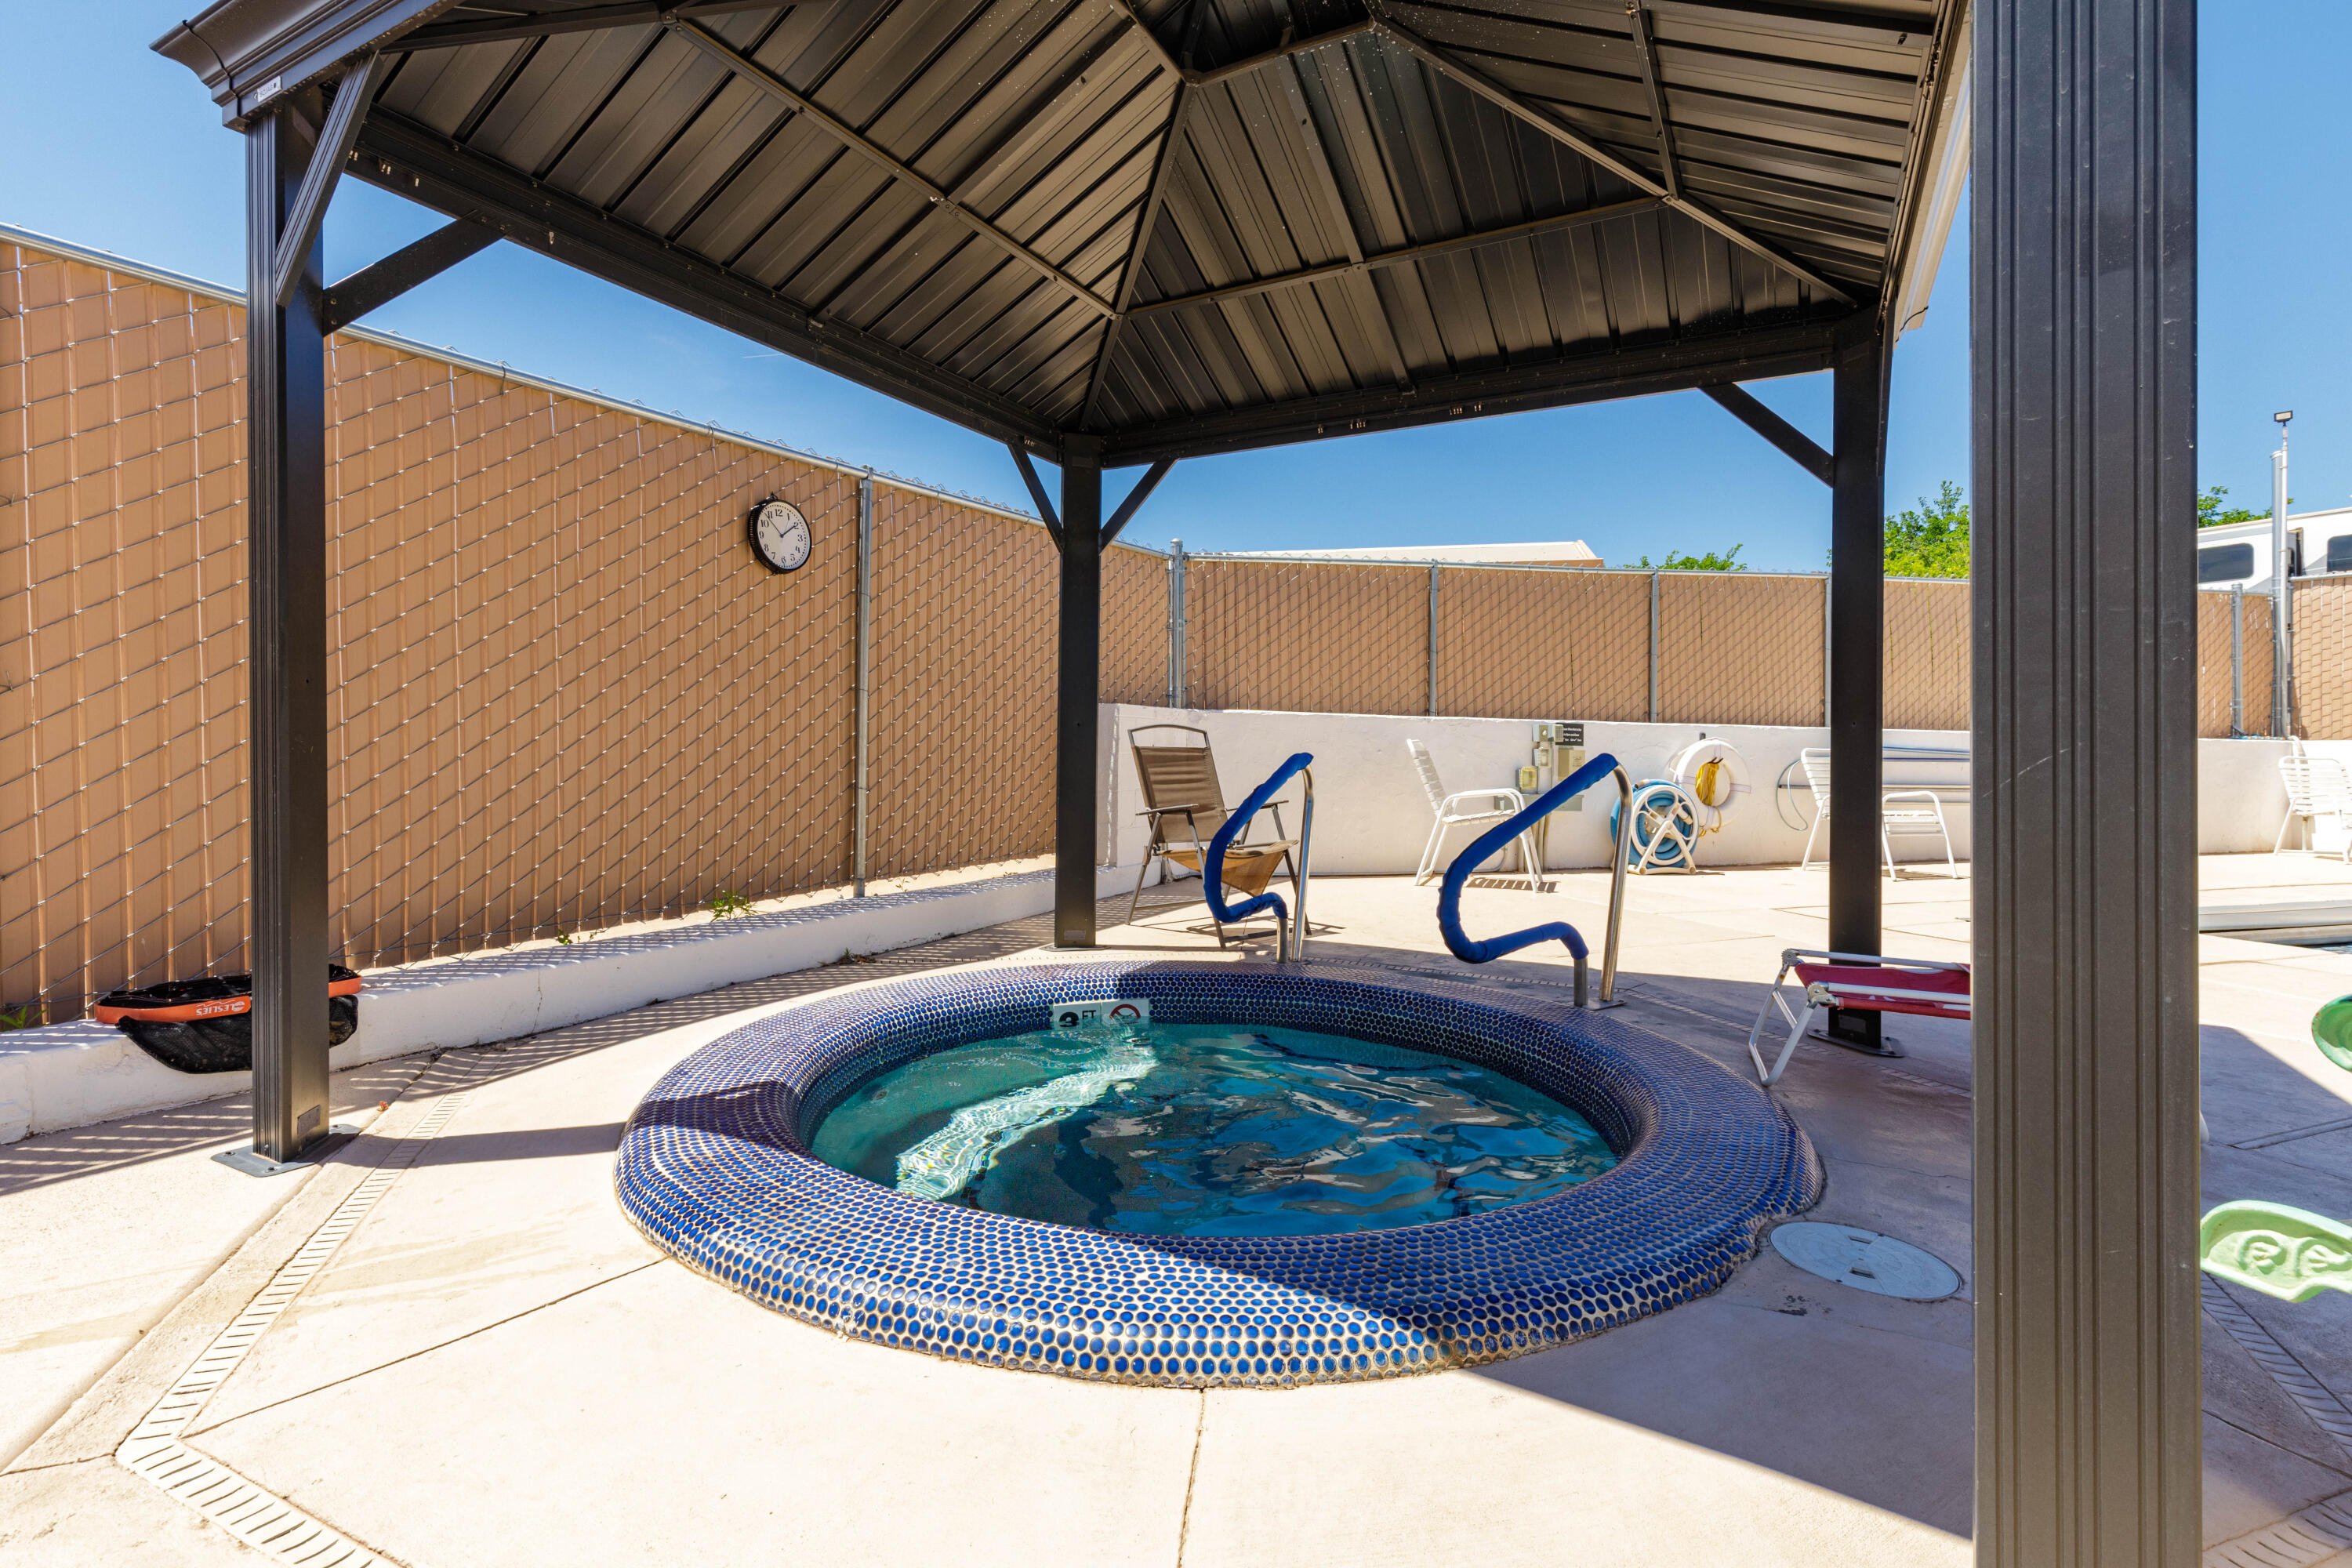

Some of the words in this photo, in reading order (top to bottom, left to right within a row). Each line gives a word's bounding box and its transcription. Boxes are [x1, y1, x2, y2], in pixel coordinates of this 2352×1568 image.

[775, 509, 782, 517] 12
[760, 519, 770, 528] 10
[764, 543, 769, 552] 8
